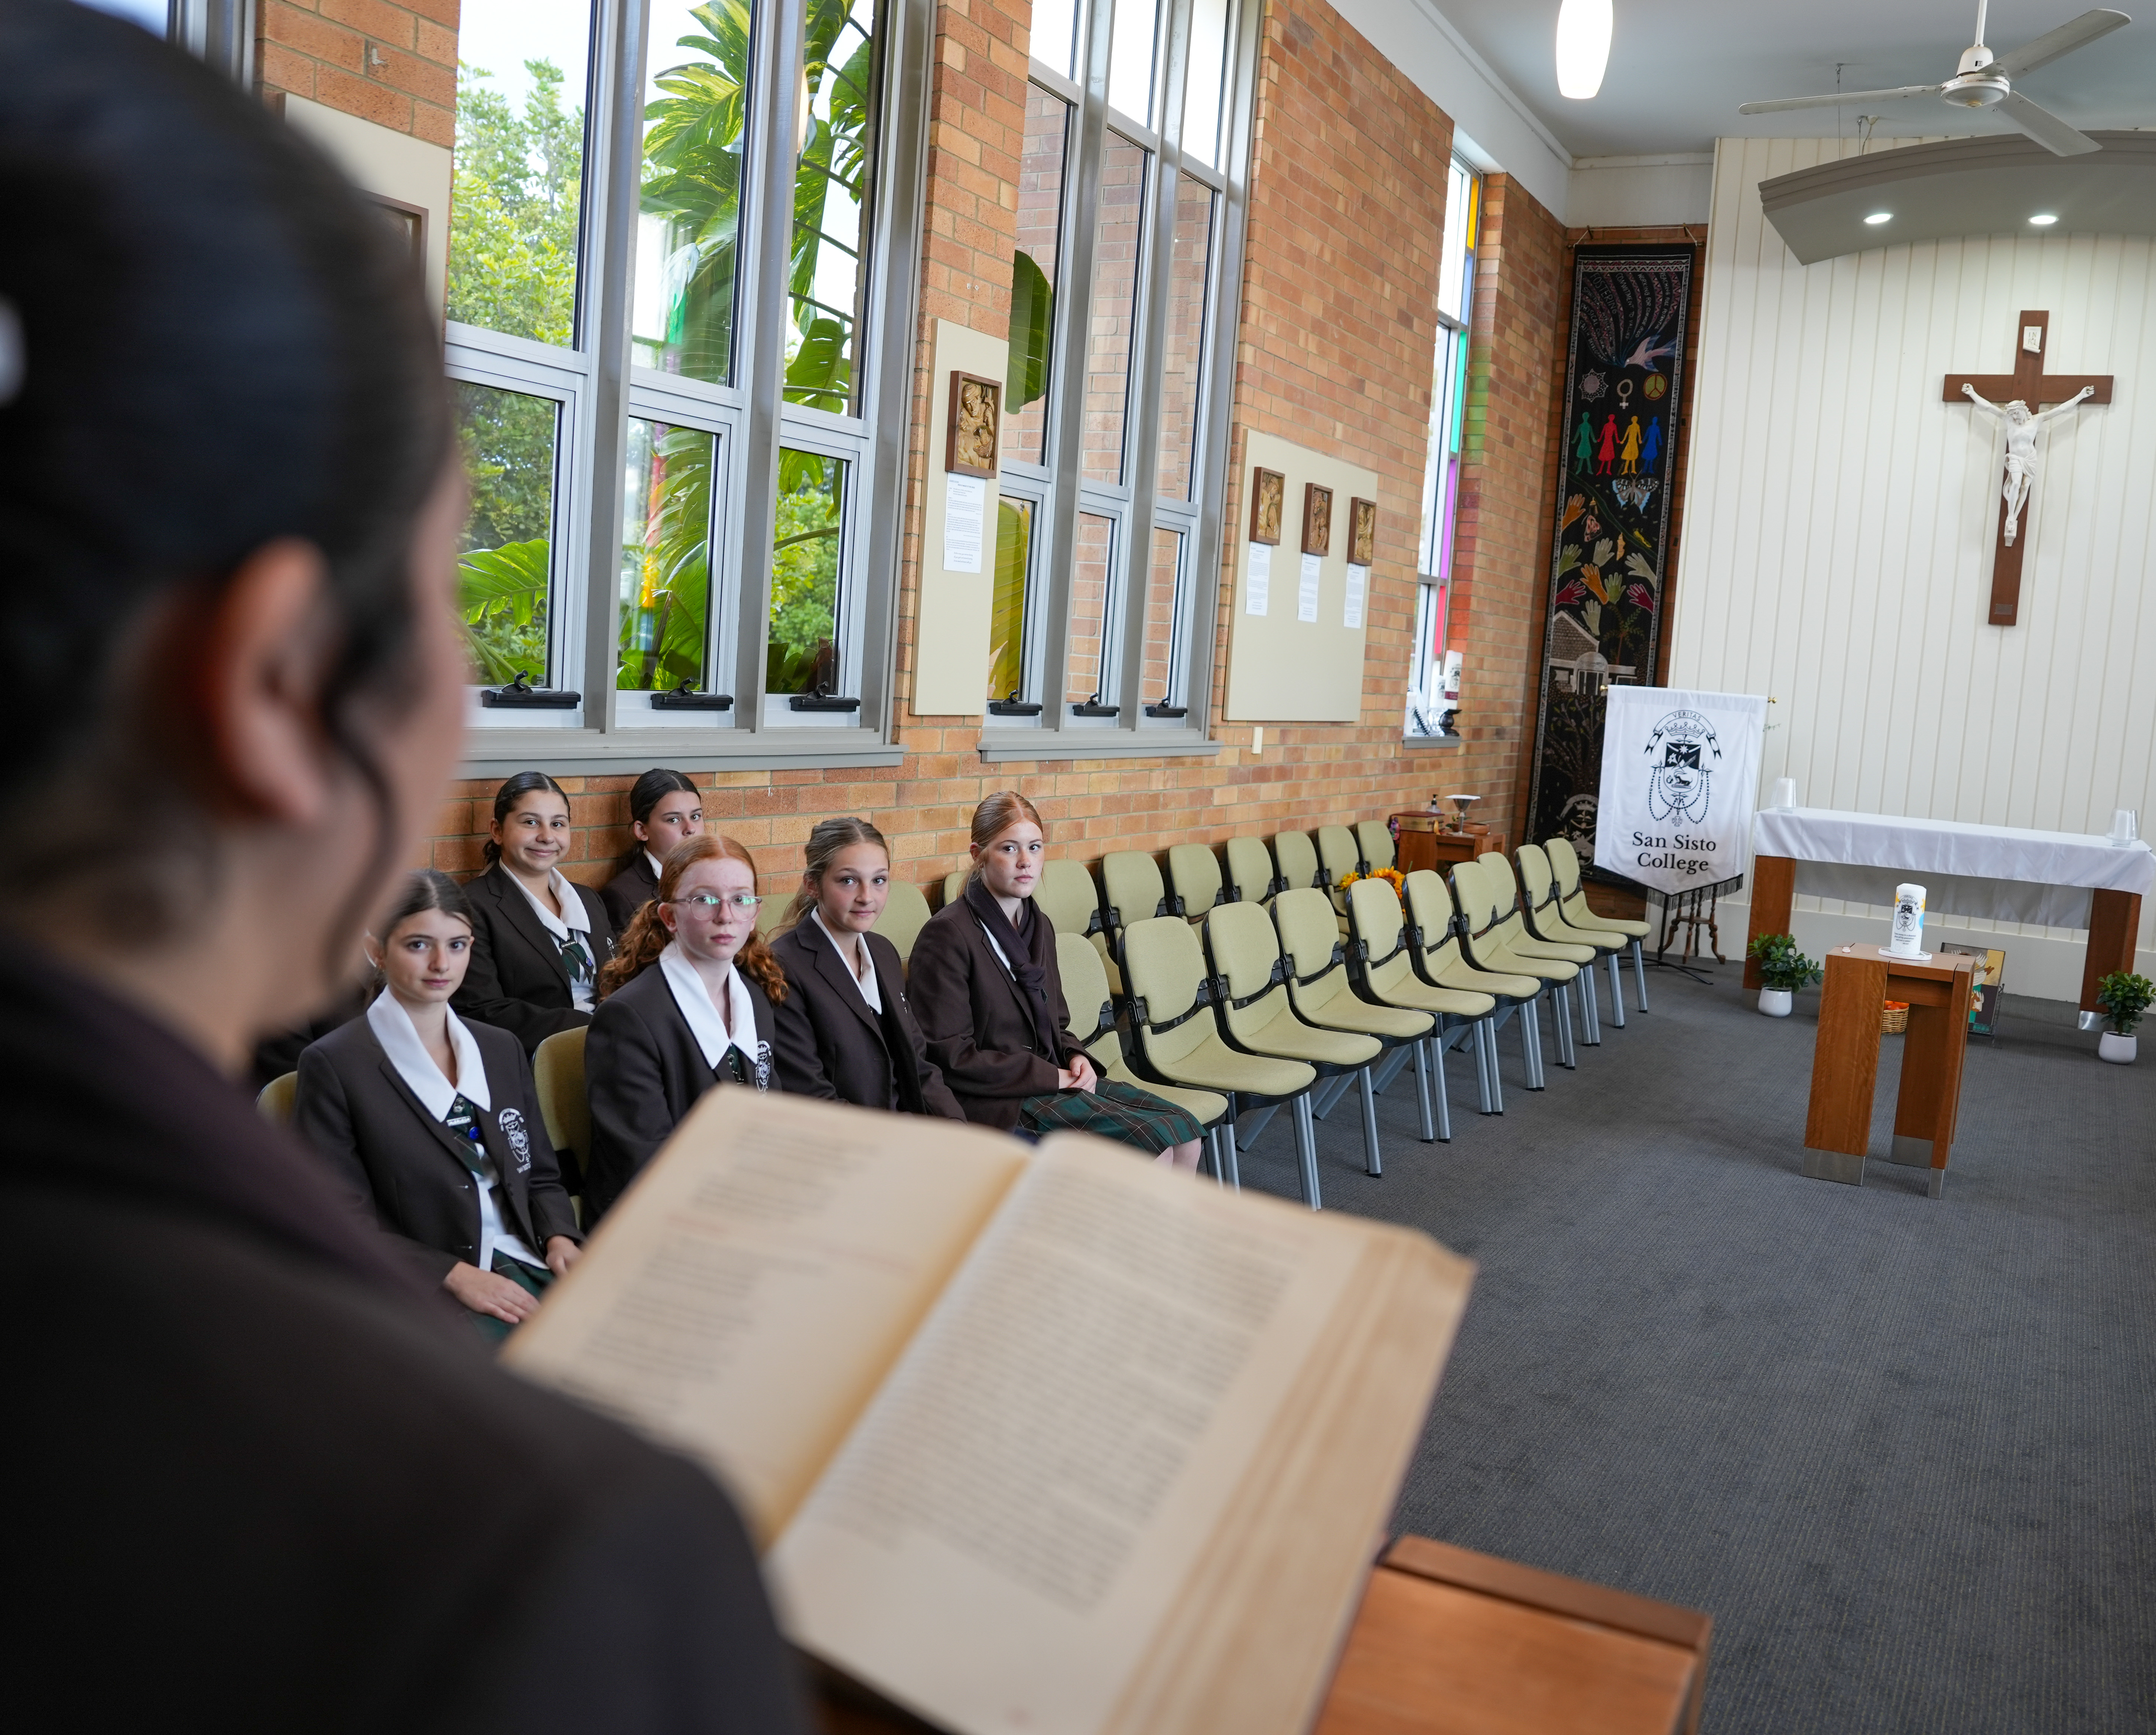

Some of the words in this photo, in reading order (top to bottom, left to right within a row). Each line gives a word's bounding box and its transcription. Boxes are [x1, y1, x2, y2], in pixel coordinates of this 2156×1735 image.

[1591, 272, 1617, 314] FOSTERING
[1616, 273, 1634, 308] COMMITMENT
[1672, 711, 1701, 721] VERITAS
[1633, 831, 1667, 848] San
[1673, 834, 1716, 851] Sisto
[1638, 852, 1709, 875] College
